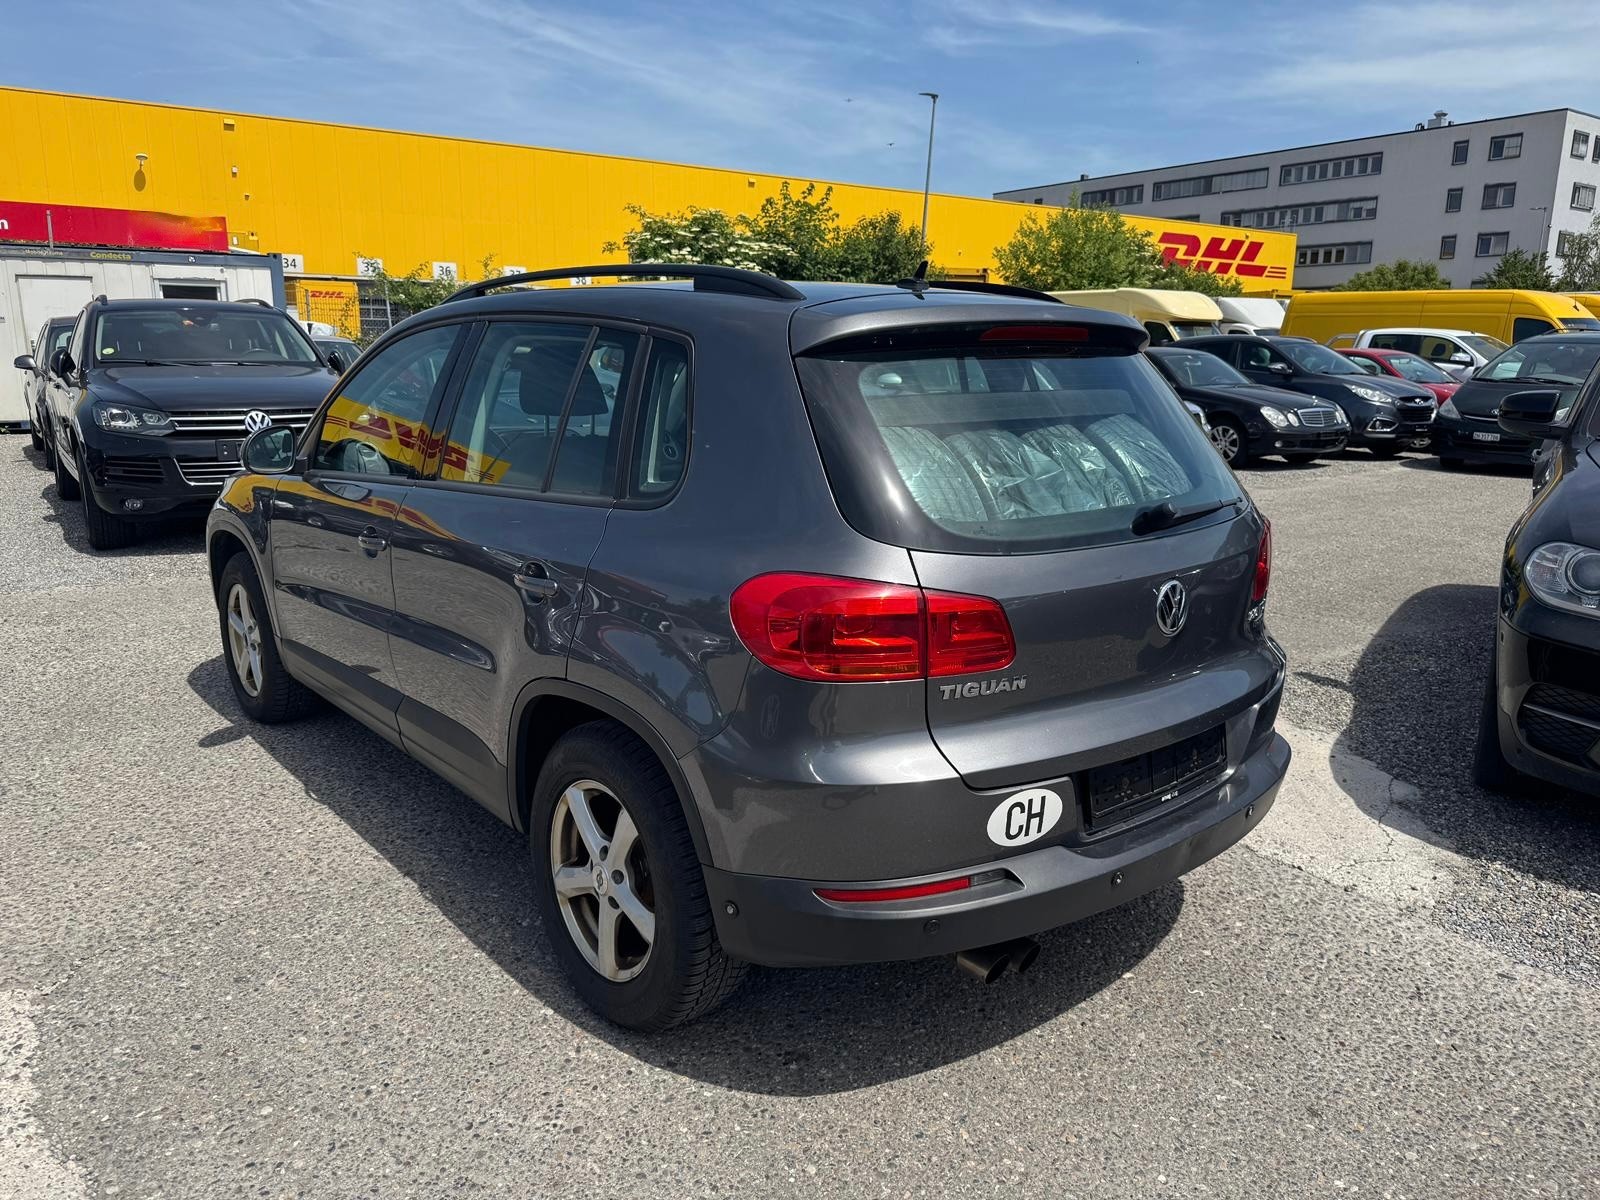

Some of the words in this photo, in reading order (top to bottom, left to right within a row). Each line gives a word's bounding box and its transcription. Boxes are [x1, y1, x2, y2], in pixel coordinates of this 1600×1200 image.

[89, 251, 132, 260] Condecta
[1158, 232, 1267, 277] DHL
[283, 257, 297, 269] 34
[439, 265, 451, 276] 36
[310, 290, 346, 299] DHL
[939, 675, 1027, 700] TIGUAN
[1005, 795, 1047, 840] CH
